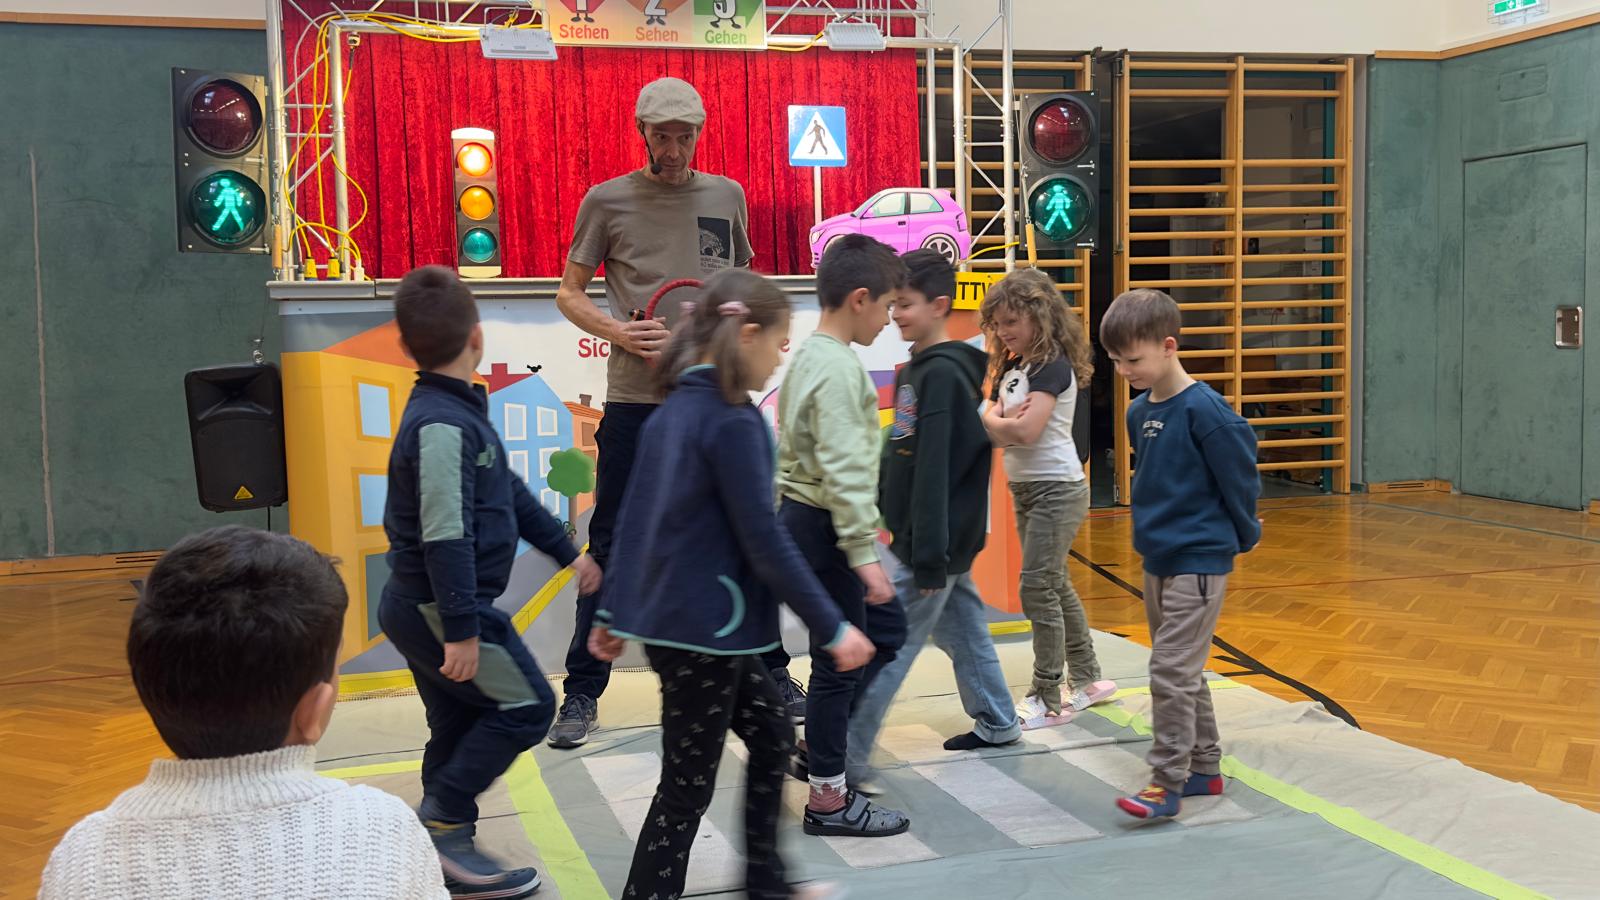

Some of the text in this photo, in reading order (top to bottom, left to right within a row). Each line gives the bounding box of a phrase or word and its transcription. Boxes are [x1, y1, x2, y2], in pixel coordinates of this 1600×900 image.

[559, 24, 609, 40] Stehen
[635, 26, 679, 42] Sehen
[704, 29, 747, 45] Gehen
